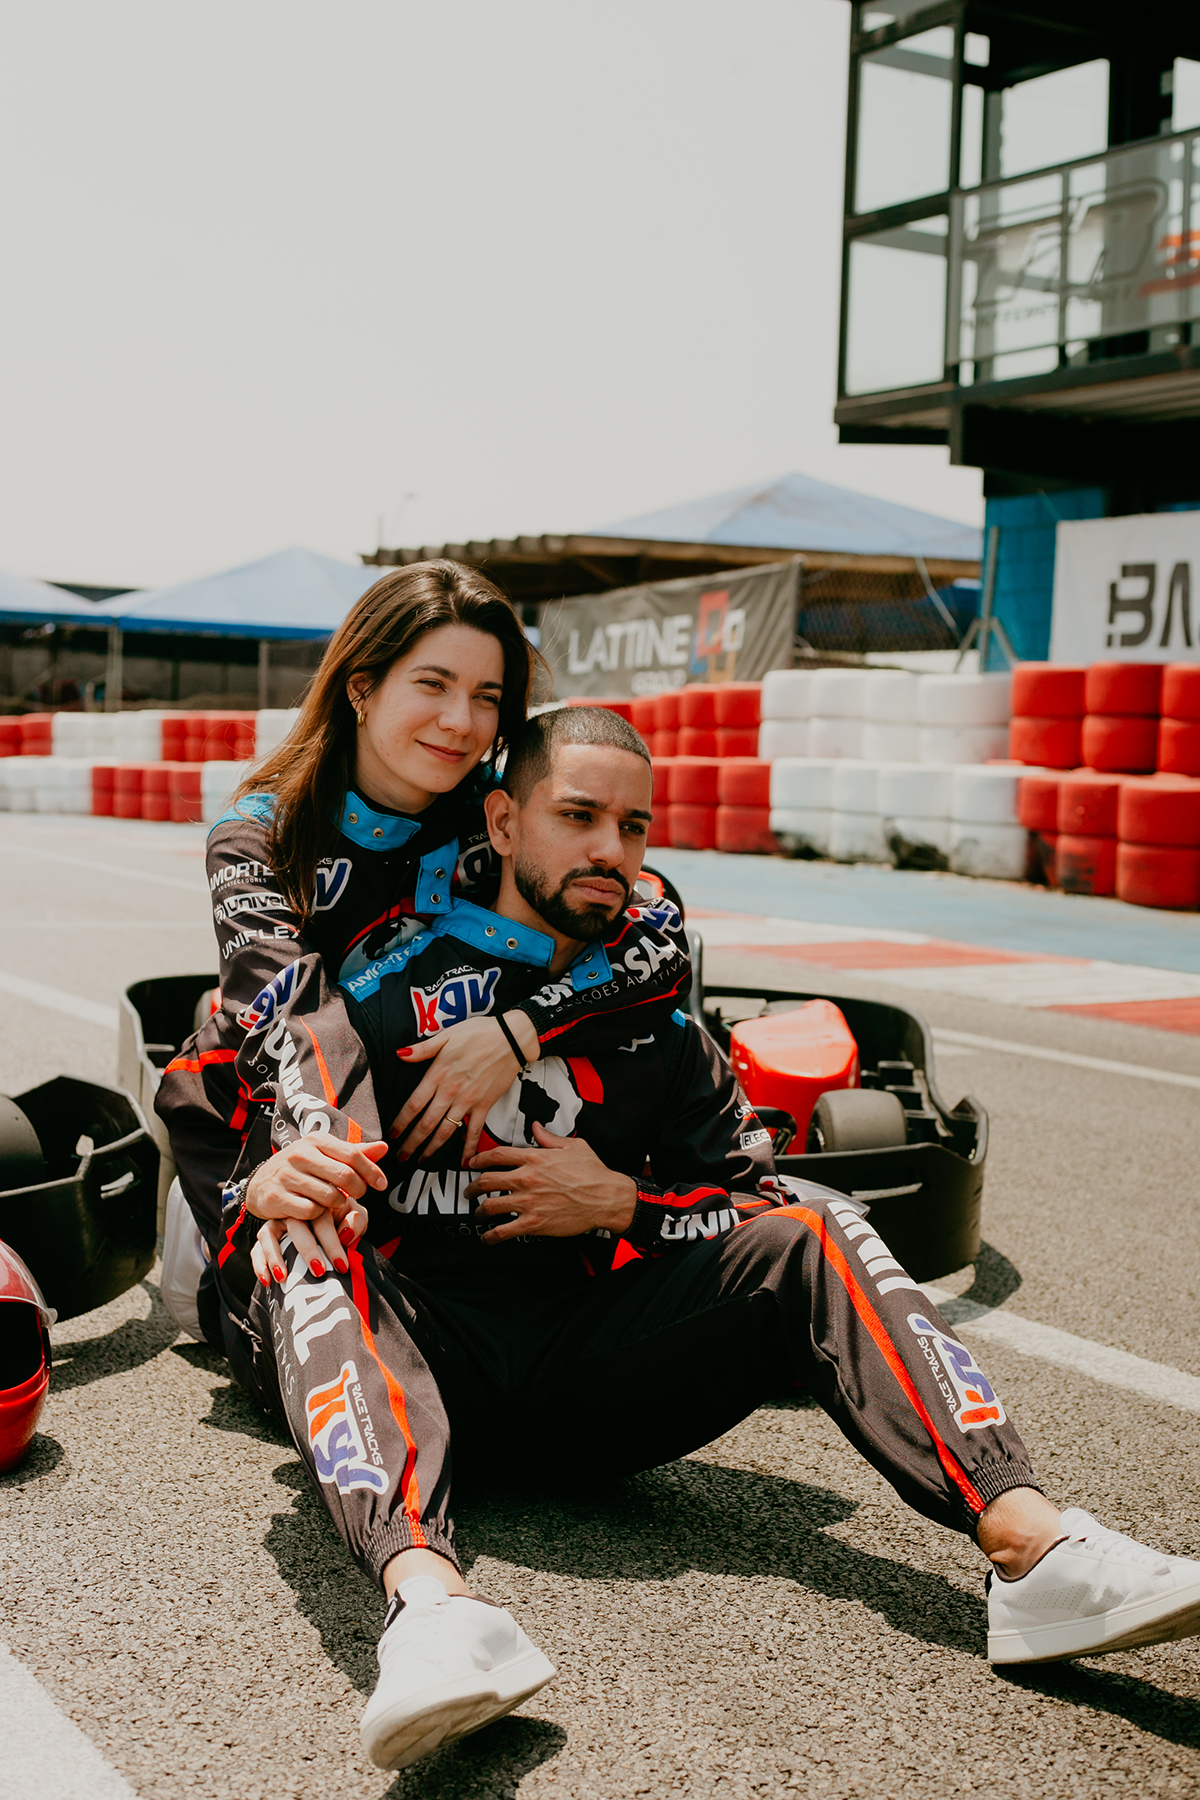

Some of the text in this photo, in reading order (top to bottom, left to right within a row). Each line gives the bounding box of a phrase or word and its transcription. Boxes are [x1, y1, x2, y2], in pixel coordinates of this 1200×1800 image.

[1107, 563, 1200, 647] BA
[567, 614, 693, 675] LATTINE
[467, 831, 491, 844] TRAC
[444, 965, 482, 977] TRACK
[917, 1336, 946, 1383] TRACKS
[350, 1382, 384, 1467] RACE TRACKS
